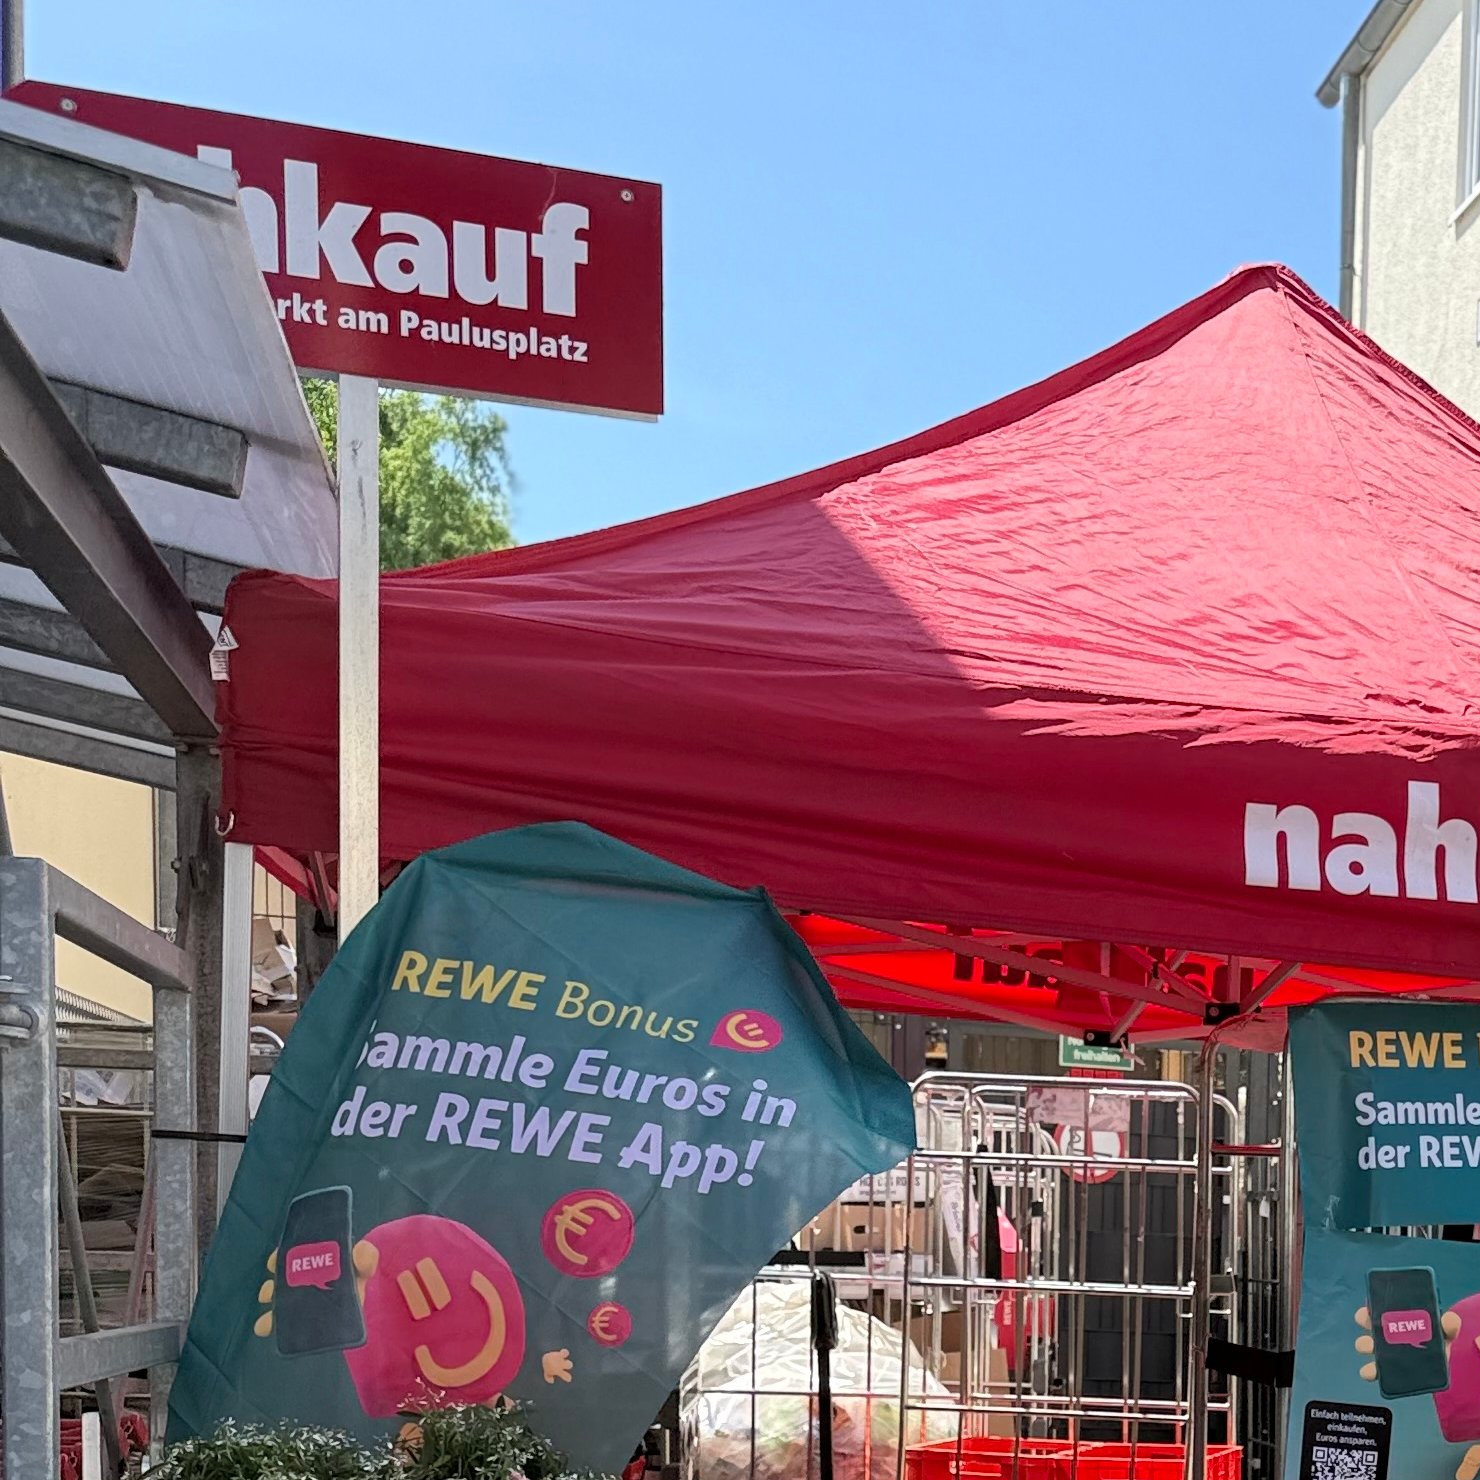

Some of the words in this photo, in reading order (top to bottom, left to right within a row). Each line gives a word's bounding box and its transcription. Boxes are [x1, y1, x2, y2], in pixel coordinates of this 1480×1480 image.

[276, 295, 327, 327] rkt
[338, 306, 389, 336] am
[400, 313, 588, 363] Paulusplatz
[391, 949, 547, 1011] REWE
[555, 979, 699, 1043] Bonus
[1349, 1030, 1467, 1068] REWE
[563, 1047, 728, 1116] Euros
[741, 1078, 797, 1128] in
[330, 1088, 416, 1138] der
[425, 1092, 611, 1164] REWE
[617, 1124, 766, 1194] App!
[1358, 1135, 1410, 1172] der
[290, 1250, 335, 1272] REWE
[1388, 1318, 1427, 1335] REWE
